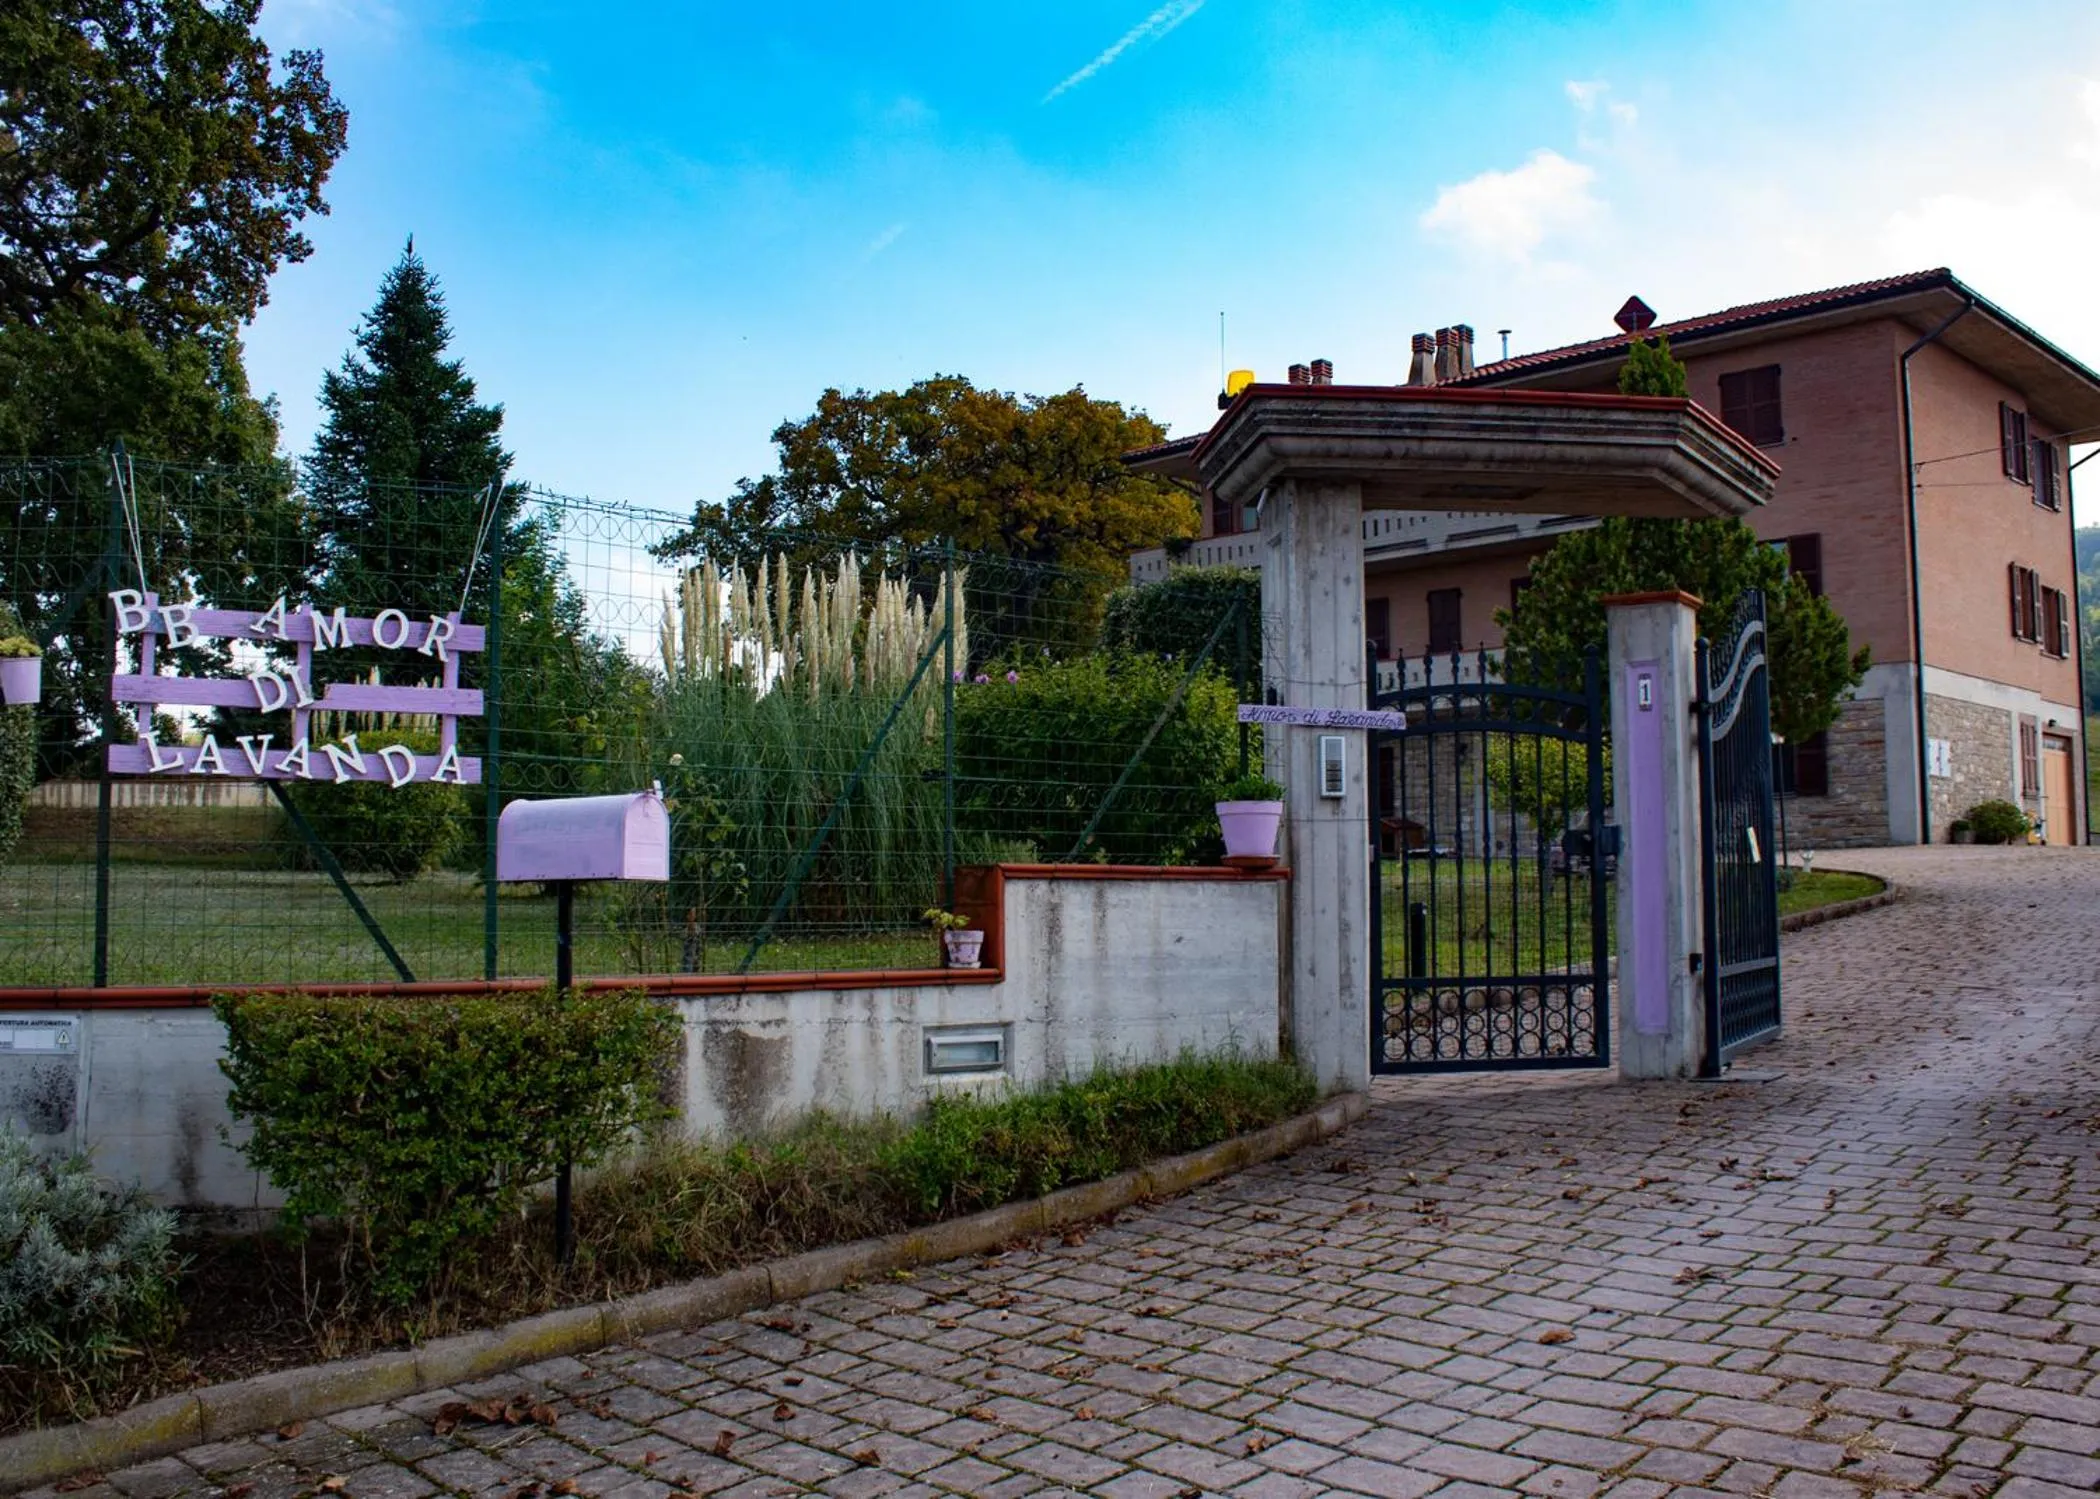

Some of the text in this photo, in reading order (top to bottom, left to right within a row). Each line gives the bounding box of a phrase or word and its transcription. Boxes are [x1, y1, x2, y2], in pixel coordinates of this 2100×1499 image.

[108, 588, 455, 662] BB AMOR
[248, 665, 314, 713] DI
[1303, 709, 1321, 724] di
[140, 730, 467, 788] LAVANDA
